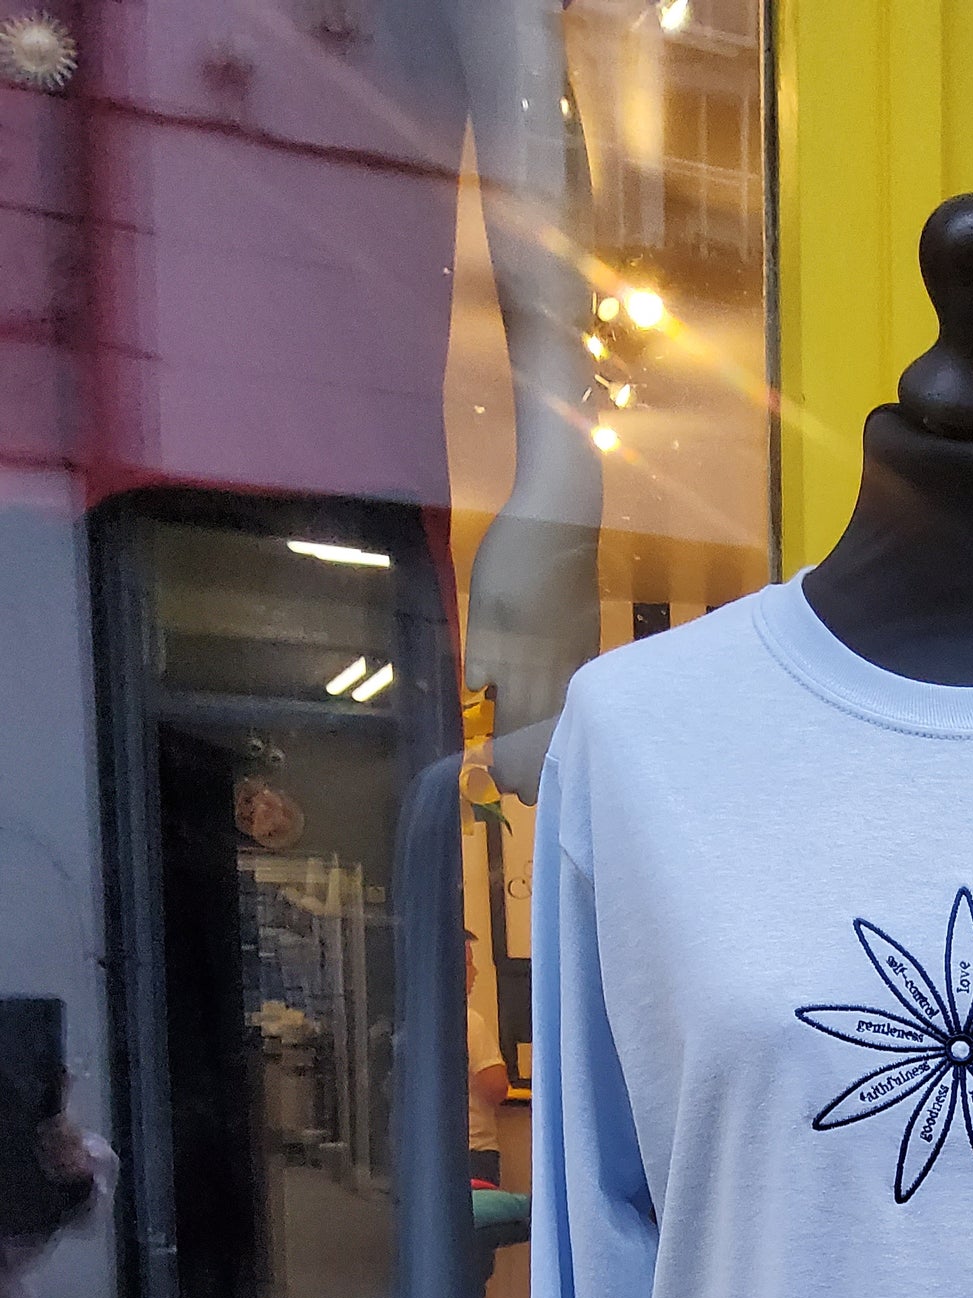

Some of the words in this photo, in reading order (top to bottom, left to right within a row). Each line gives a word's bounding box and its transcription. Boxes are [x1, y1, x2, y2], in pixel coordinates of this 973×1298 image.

[956, 961, 971, 994] love
[855, 1019, 925, 1043] gentleness
[919, 1083, 950, 1143] goodness
